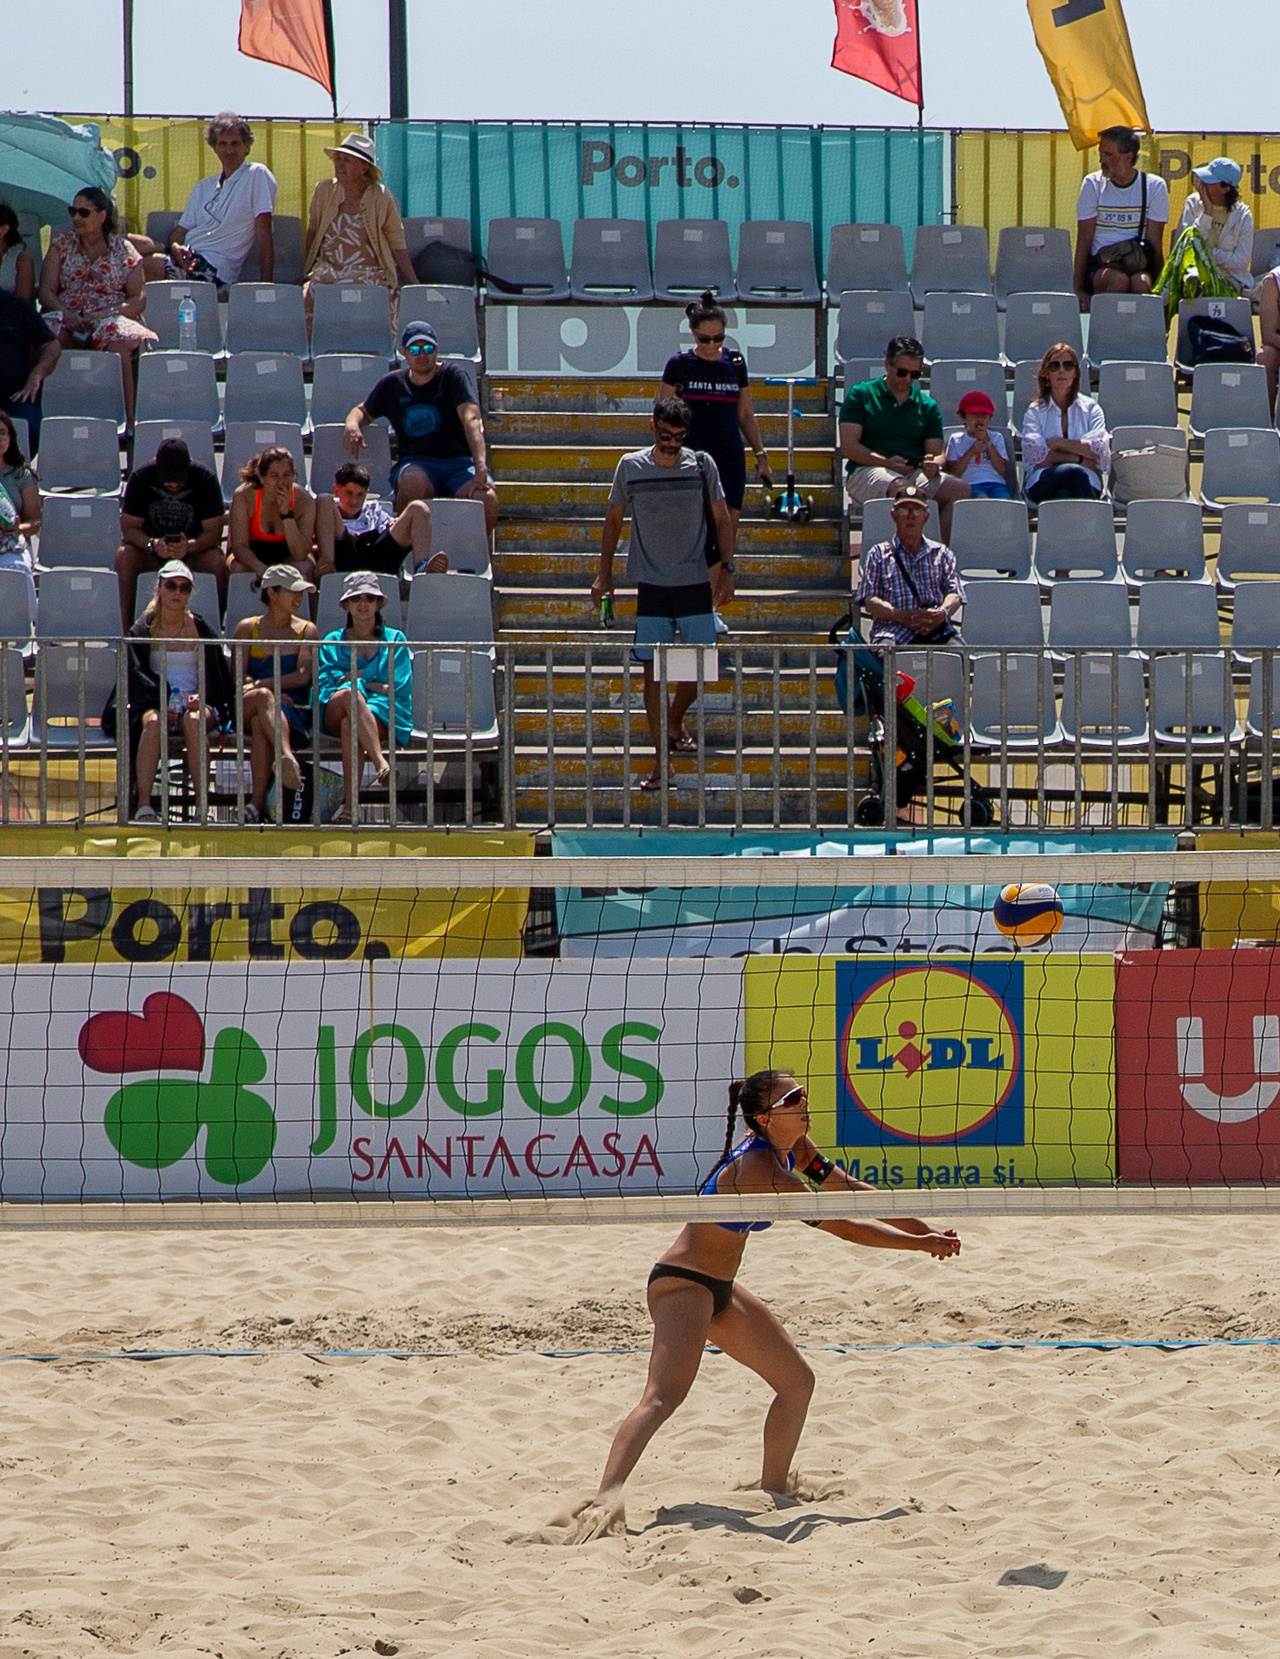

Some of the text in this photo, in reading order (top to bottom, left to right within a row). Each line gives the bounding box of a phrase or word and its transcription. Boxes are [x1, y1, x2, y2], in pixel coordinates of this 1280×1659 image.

[582, 140, 740, 189] Porto.
[688, 381, 713, 391] SANTA
[38, 887, 391, 963] Porto.
[308, 1021, 665, 1156] JOGOS
[835, 1158, 1025, 1189] Mais para si.
